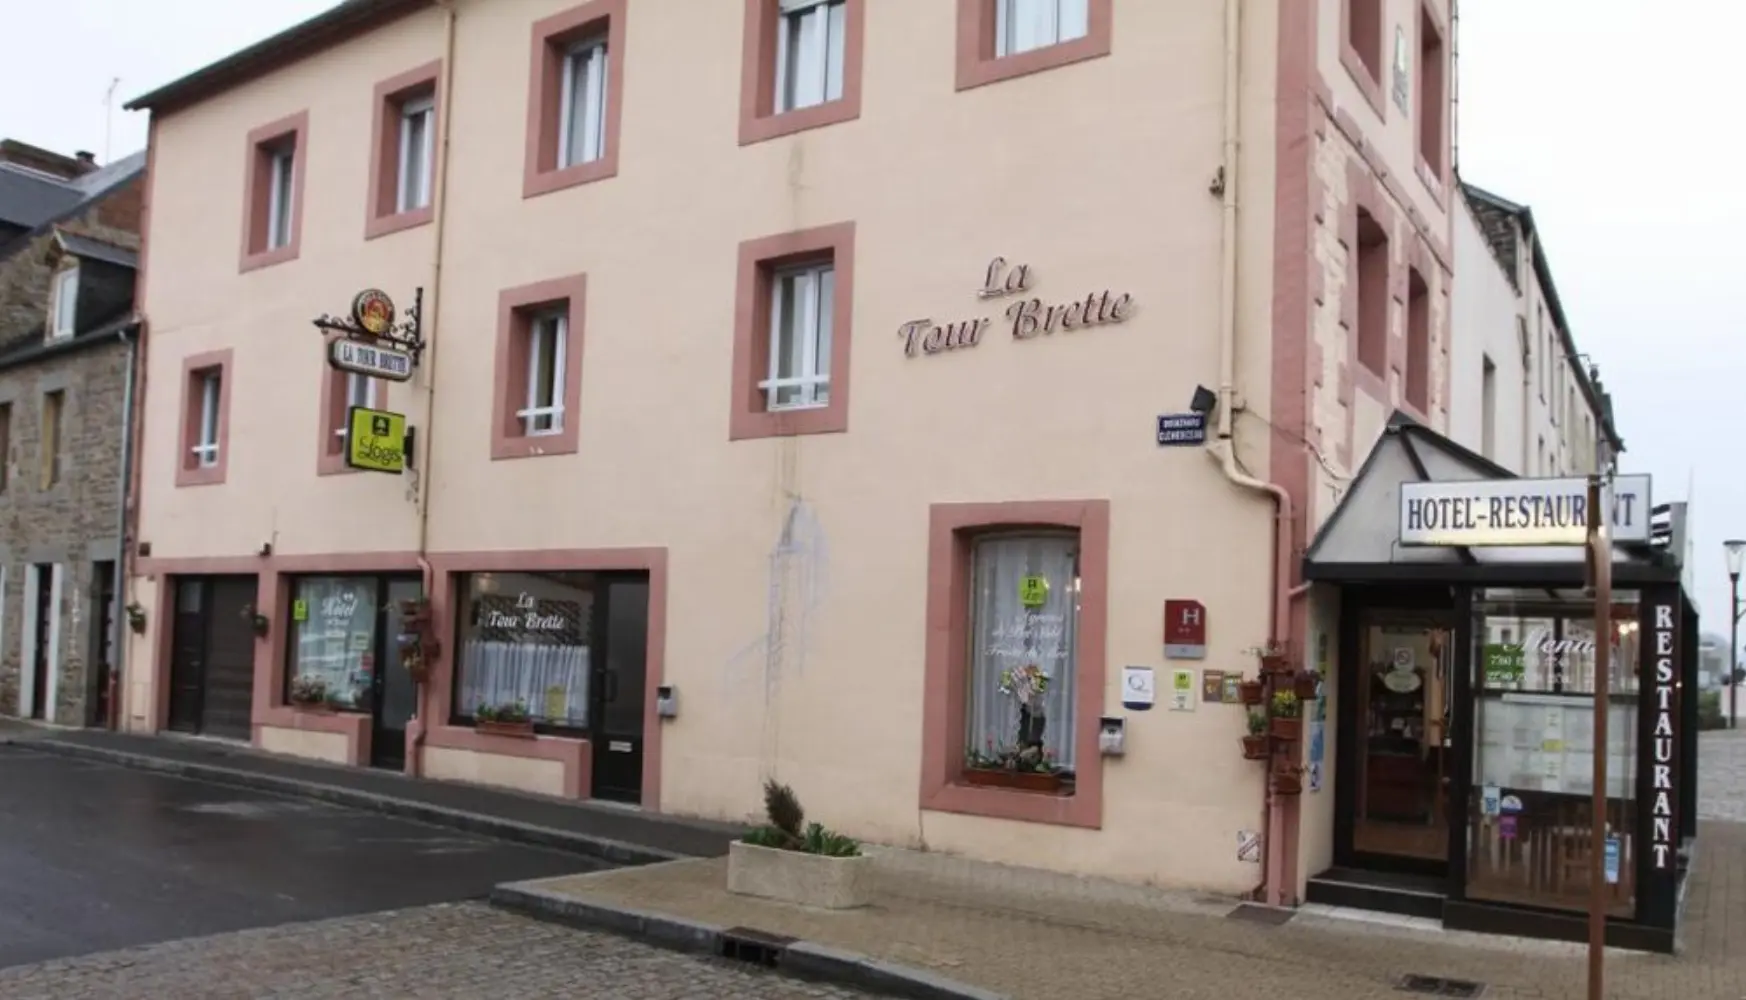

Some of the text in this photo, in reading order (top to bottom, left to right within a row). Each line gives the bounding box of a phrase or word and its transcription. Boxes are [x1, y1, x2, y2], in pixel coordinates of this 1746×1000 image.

[978, 256, 1029, 300] La
[898, 289, 1133, 357] Tour Brette
[1408, 493, 1637, 530] HOTEL-RESTAURNT
[515, 591, 535, 608] La
[1182, 607, 1200, 626] H
[488, 609, 565, 630] Tour Brette
[1653, 604, 1674, 868] RESTAURANT
